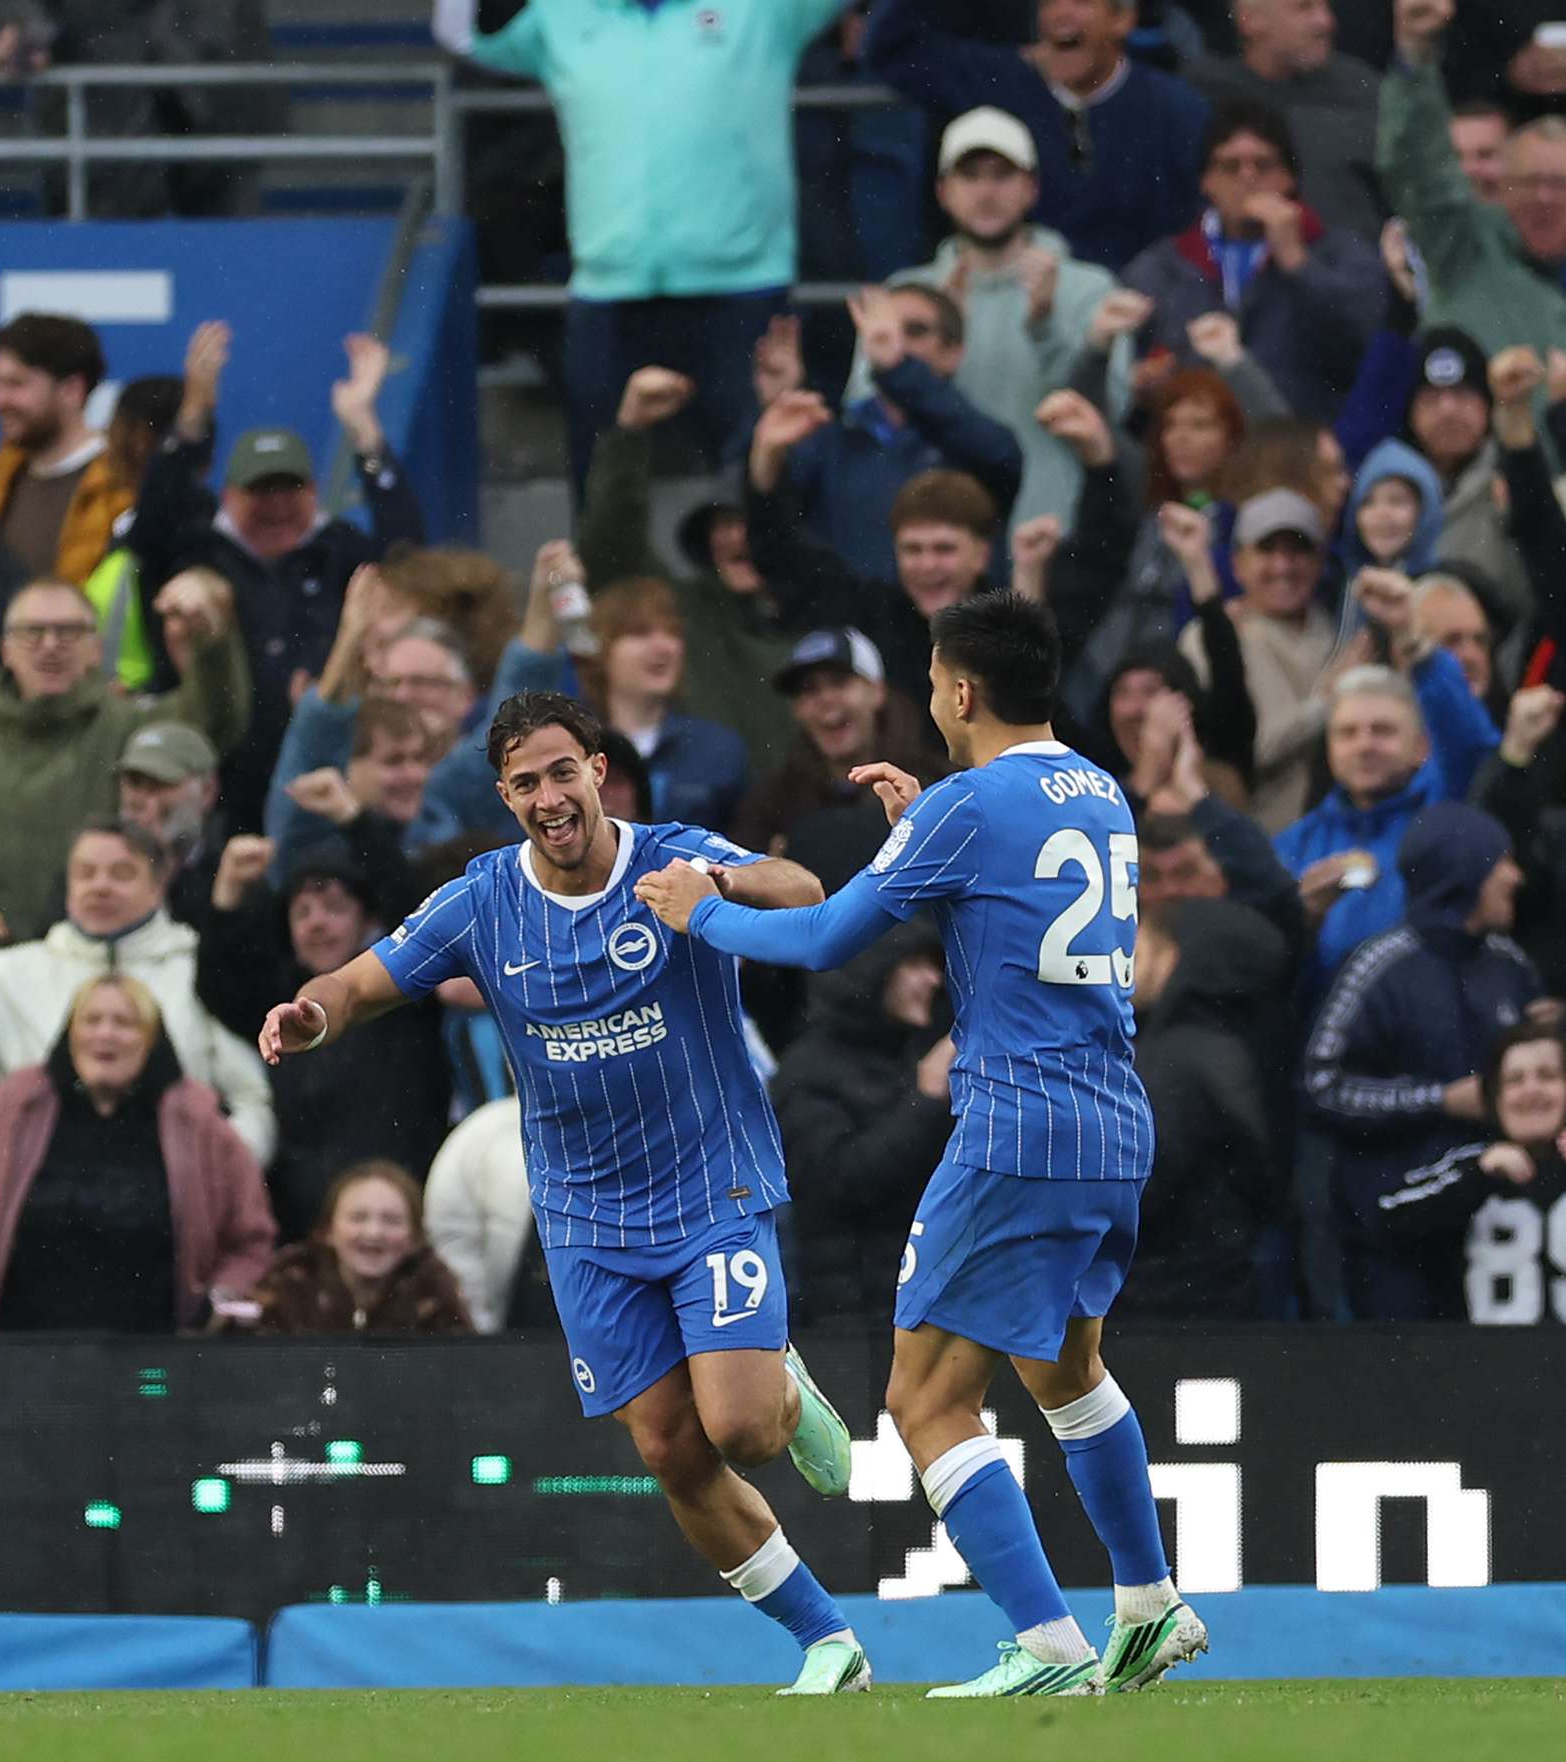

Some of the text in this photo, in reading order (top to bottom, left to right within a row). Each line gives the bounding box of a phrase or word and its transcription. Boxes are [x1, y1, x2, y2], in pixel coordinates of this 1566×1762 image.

[1034, 828, 1138, 988] 25
[526, 1001, 663, 1041] AMERICAN
[546, 1020, 667, 1062] EXPRESS
[706, 1250, 767, 1310] 19
[1465, 1195, 1566, 1325] 8
